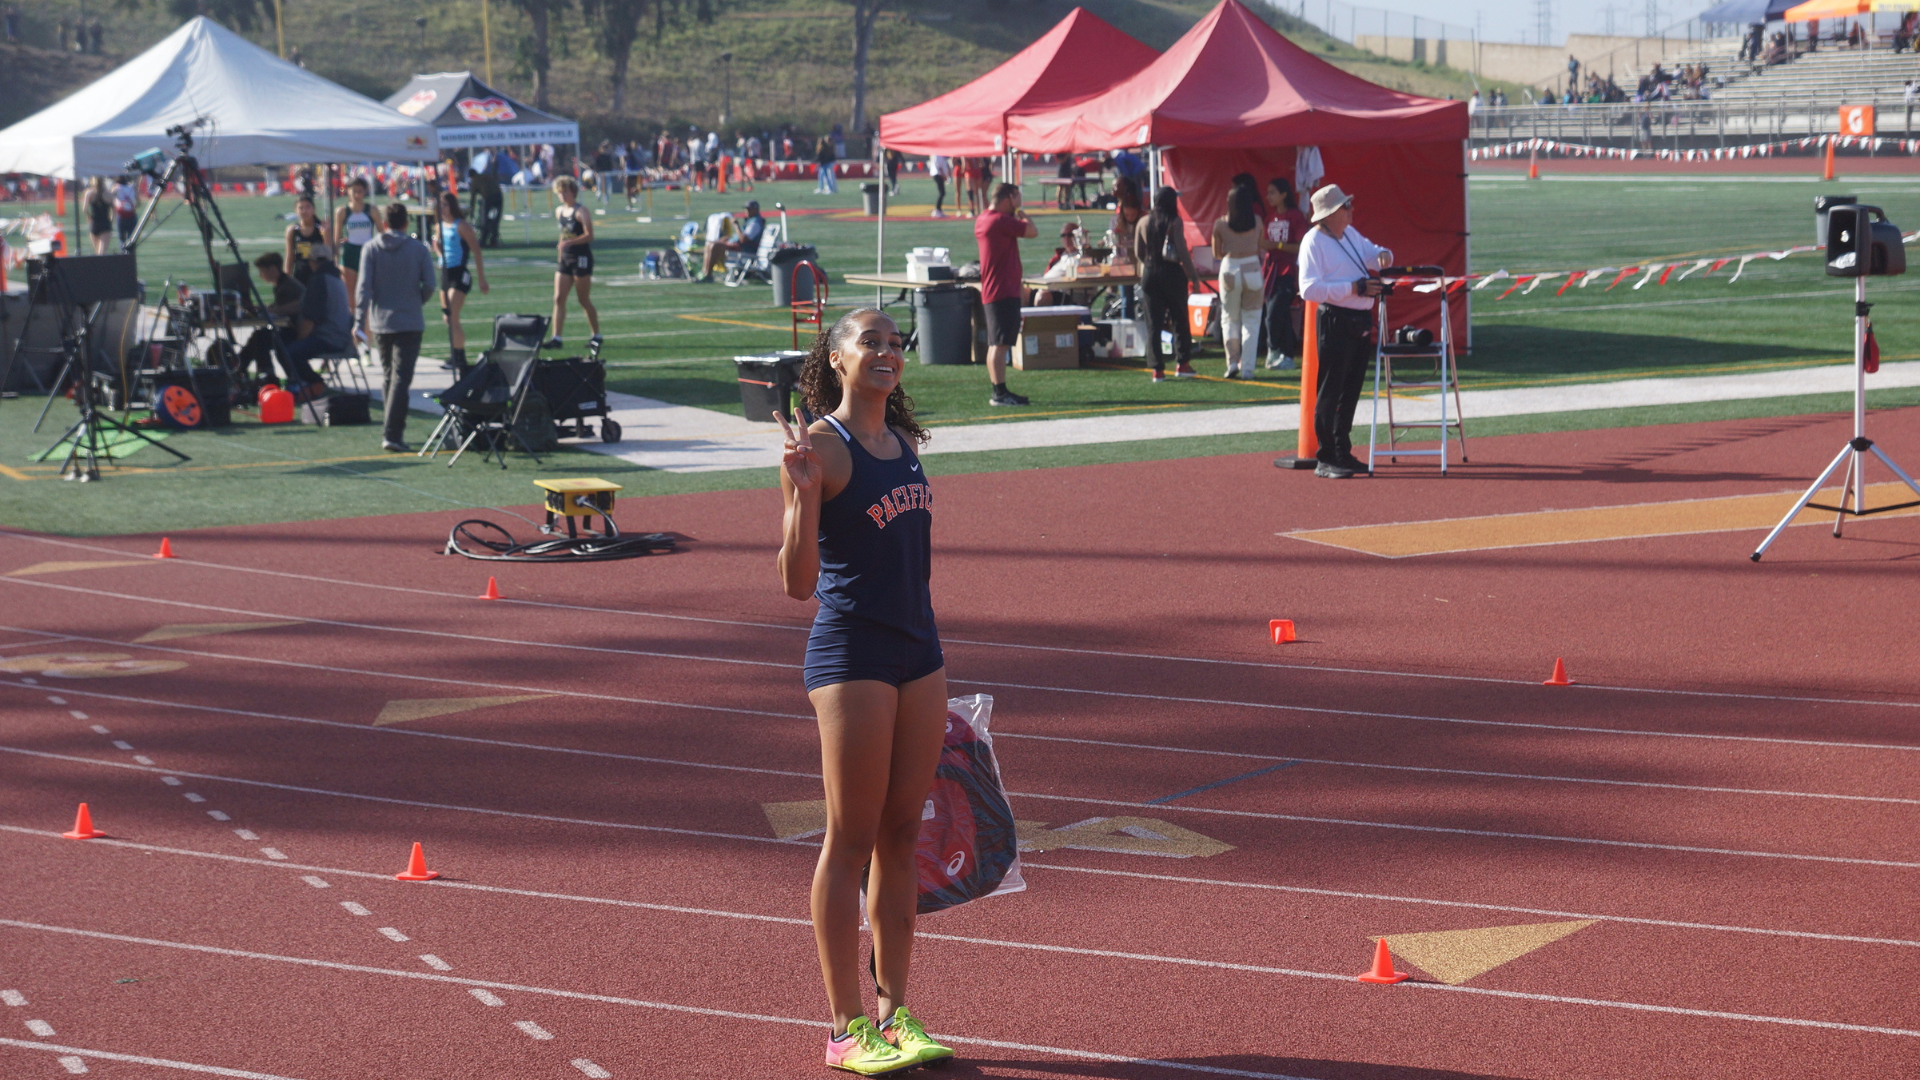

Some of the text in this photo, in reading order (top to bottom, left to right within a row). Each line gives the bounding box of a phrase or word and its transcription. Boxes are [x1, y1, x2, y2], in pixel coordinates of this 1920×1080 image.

[1848, 107, 1863, 134] G
[1193, 308, 1203, 328] G
[866, 483, 932, 529] PACIFIC
